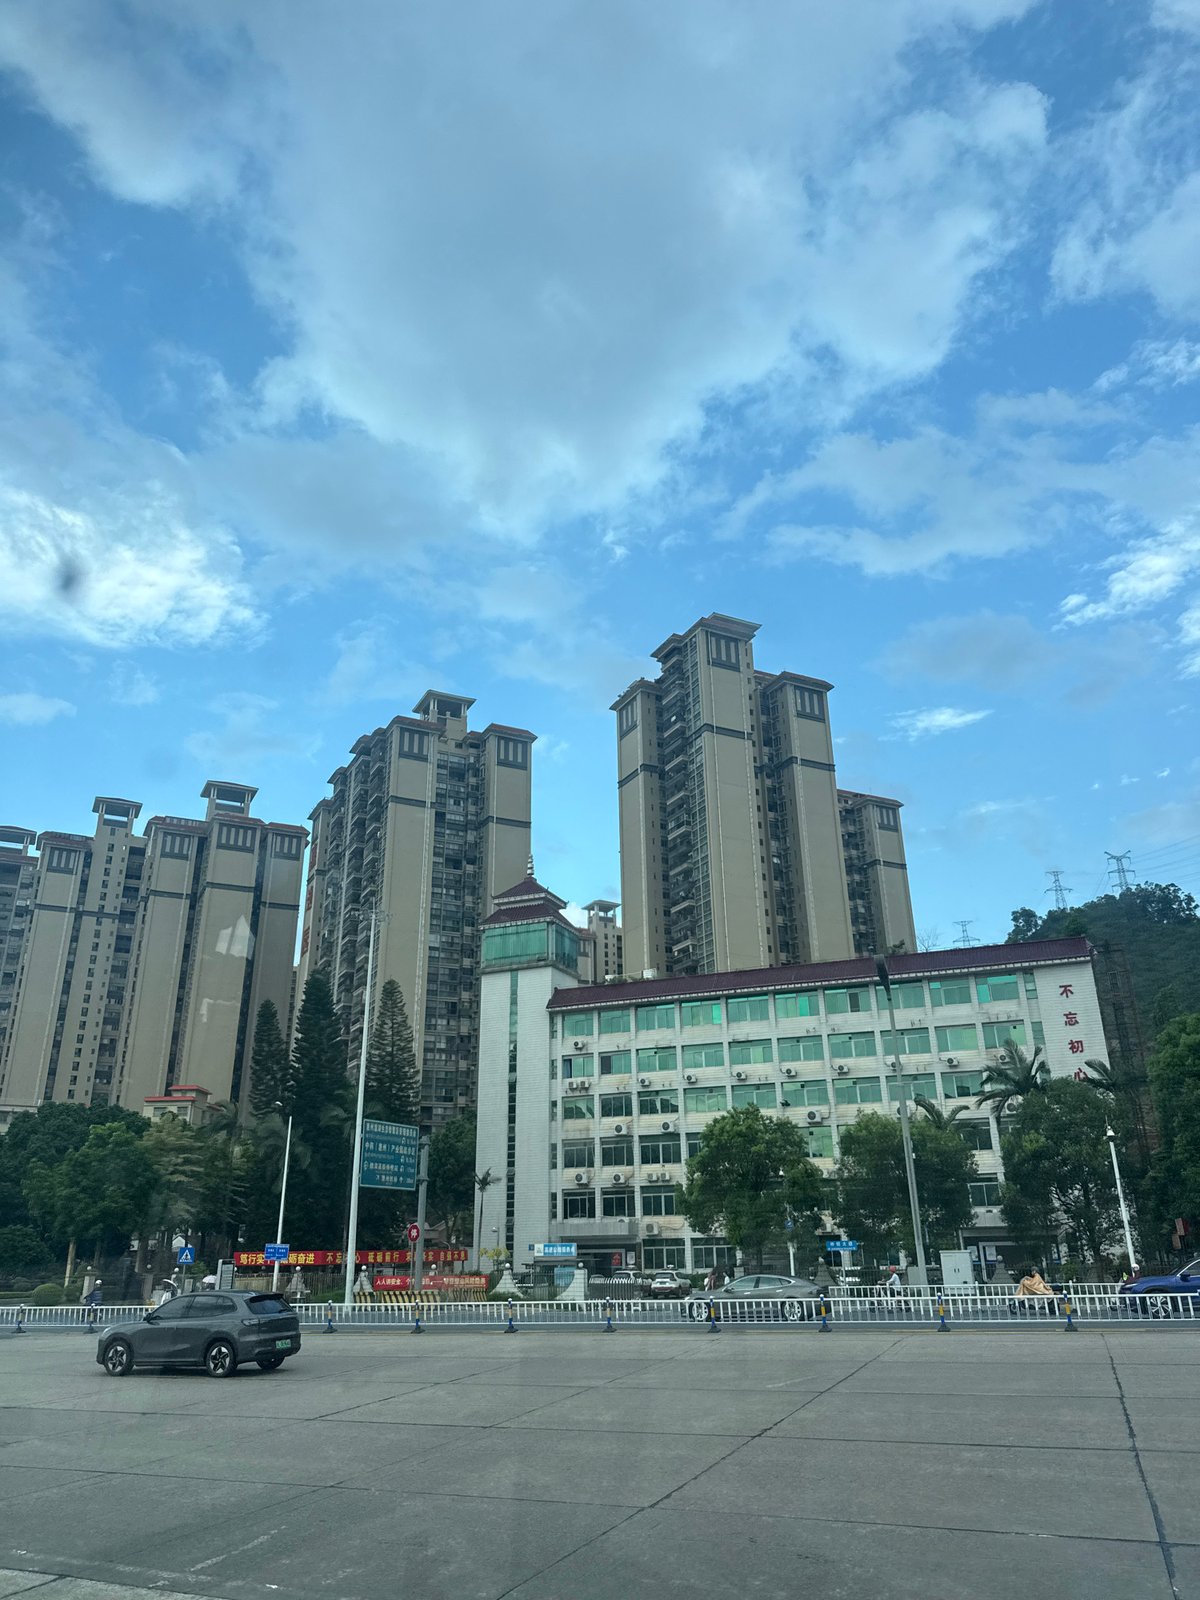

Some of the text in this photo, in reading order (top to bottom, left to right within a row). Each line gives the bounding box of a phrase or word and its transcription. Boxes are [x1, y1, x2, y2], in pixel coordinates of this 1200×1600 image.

[1059, 983, 1089, 1081] 不忘初心
[326, 1252, 361, 1264] 不忘心
